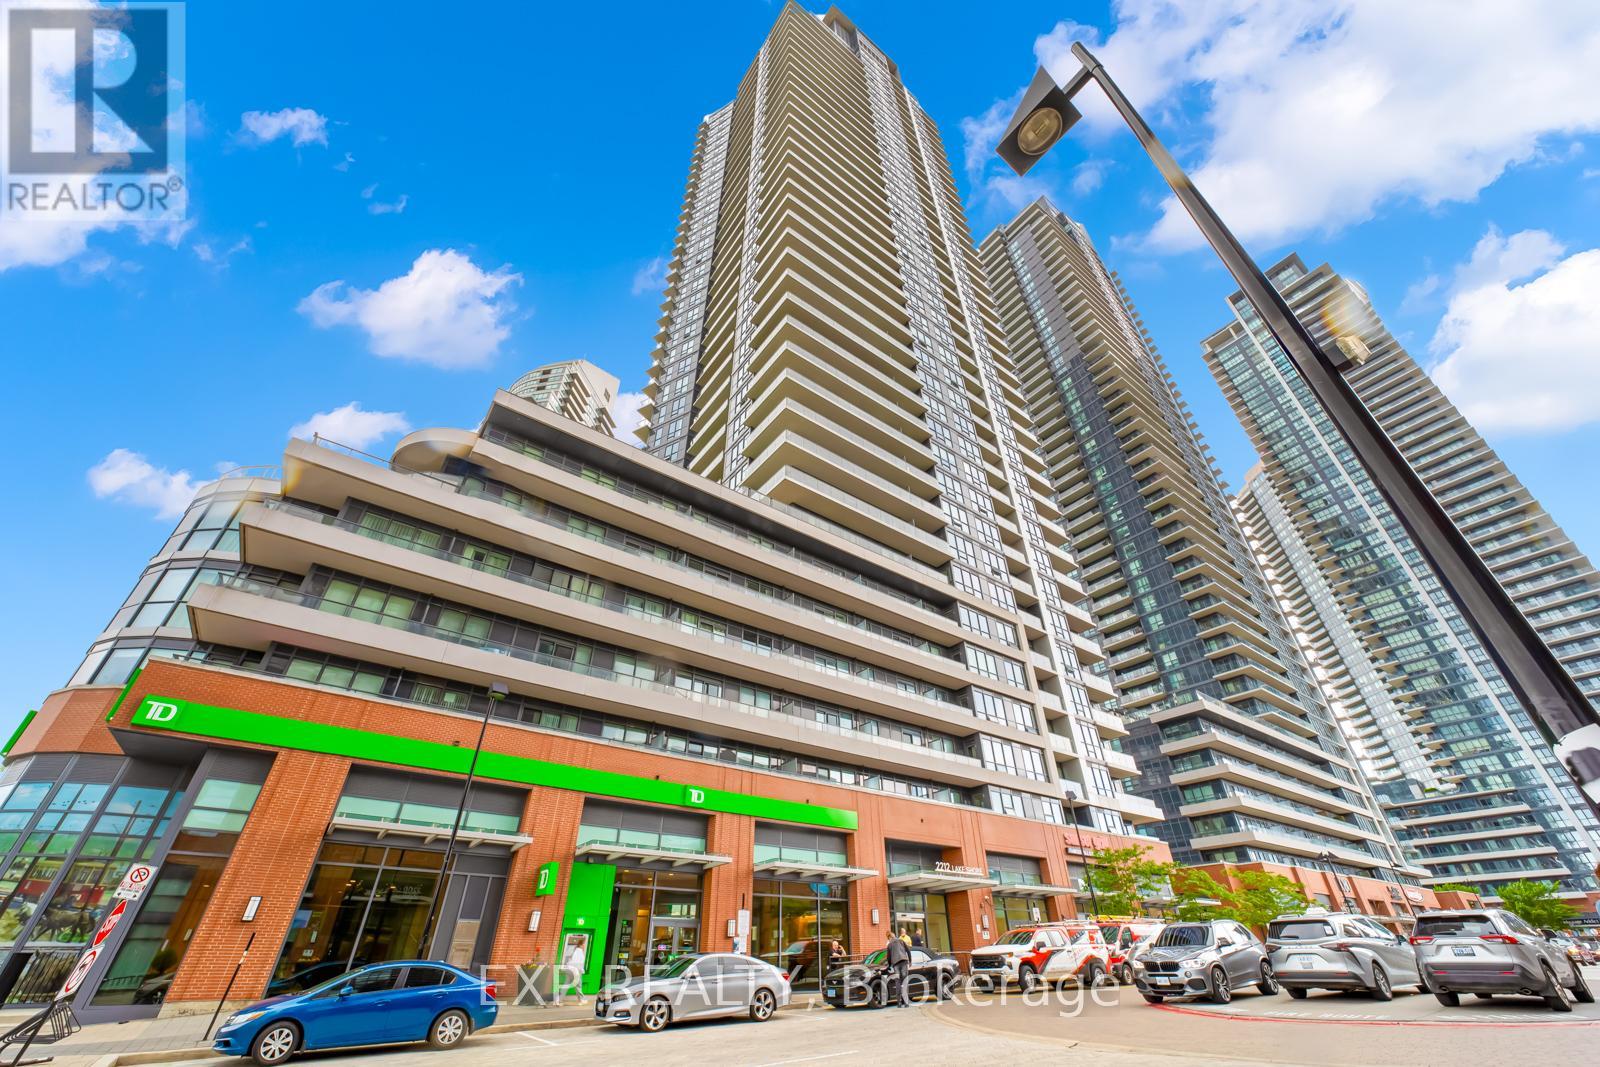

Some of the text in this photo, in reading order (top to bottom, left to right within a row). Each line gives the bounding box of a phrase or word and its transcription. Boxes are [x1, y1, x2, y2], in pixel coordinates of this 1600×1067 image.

[146, 701, 177, 721] TD
[689, 789, 704, 803] TD
[935, 862, 950, 871] 2212
